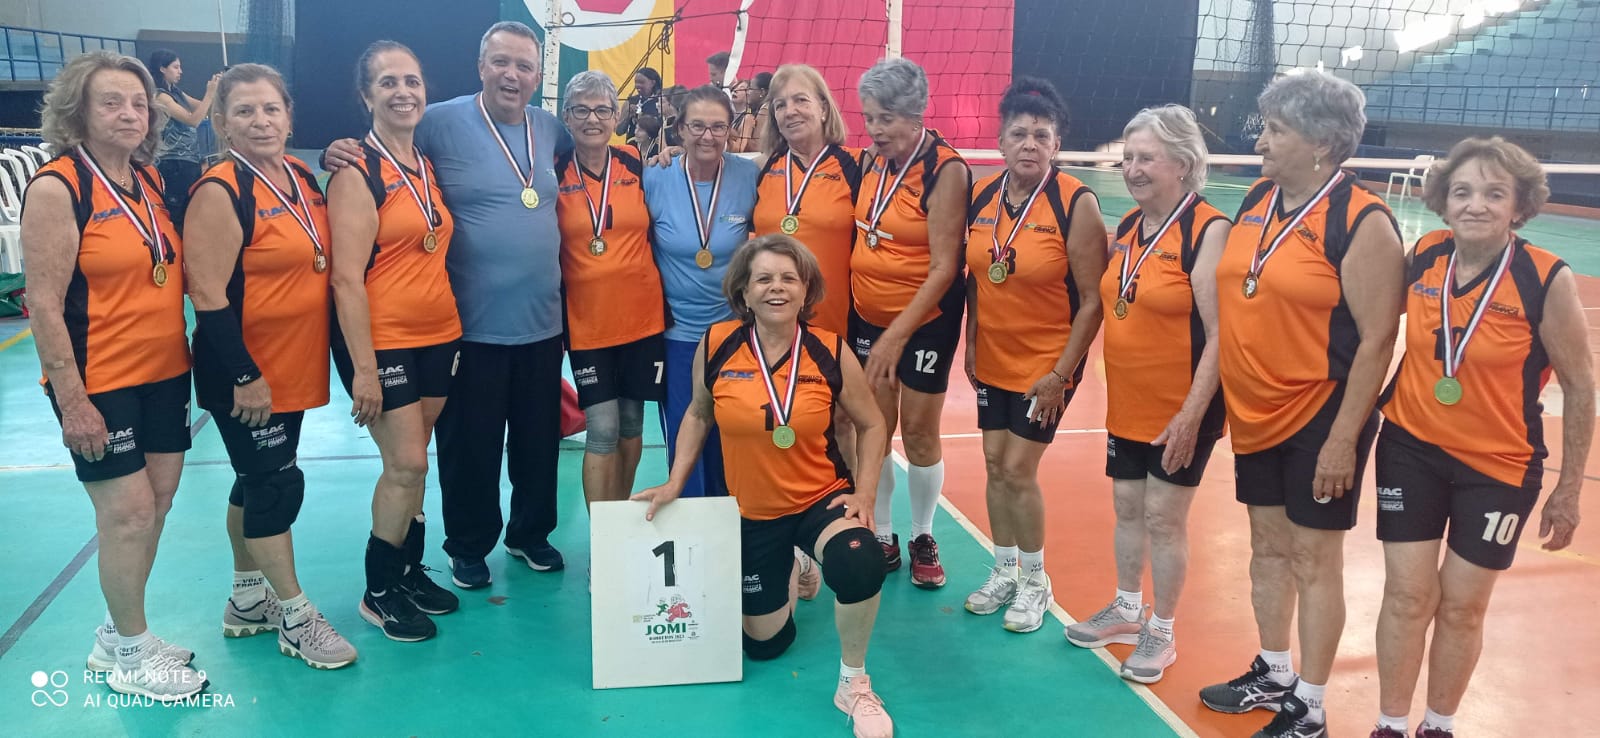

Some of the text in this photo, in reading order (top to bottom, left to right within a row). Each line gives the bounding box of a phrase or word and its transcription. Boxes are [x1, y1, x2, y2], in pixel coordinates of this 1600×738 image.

[914, 349, 938, 374] 12
[378, 365, 405, 375] EAC
[653, 361, 665, 385] 7
[107, 427, 134, 441] EAC
[252, 422, 286, 439] FEAC
[113, 440, 137, 454] FRANCA
[268, 434, 289, 449] FRANCA
[1482, 511, 1520, 546] 10
[652, 540, 676, 587] 1
[645, 622, 687, 637] JOMI
